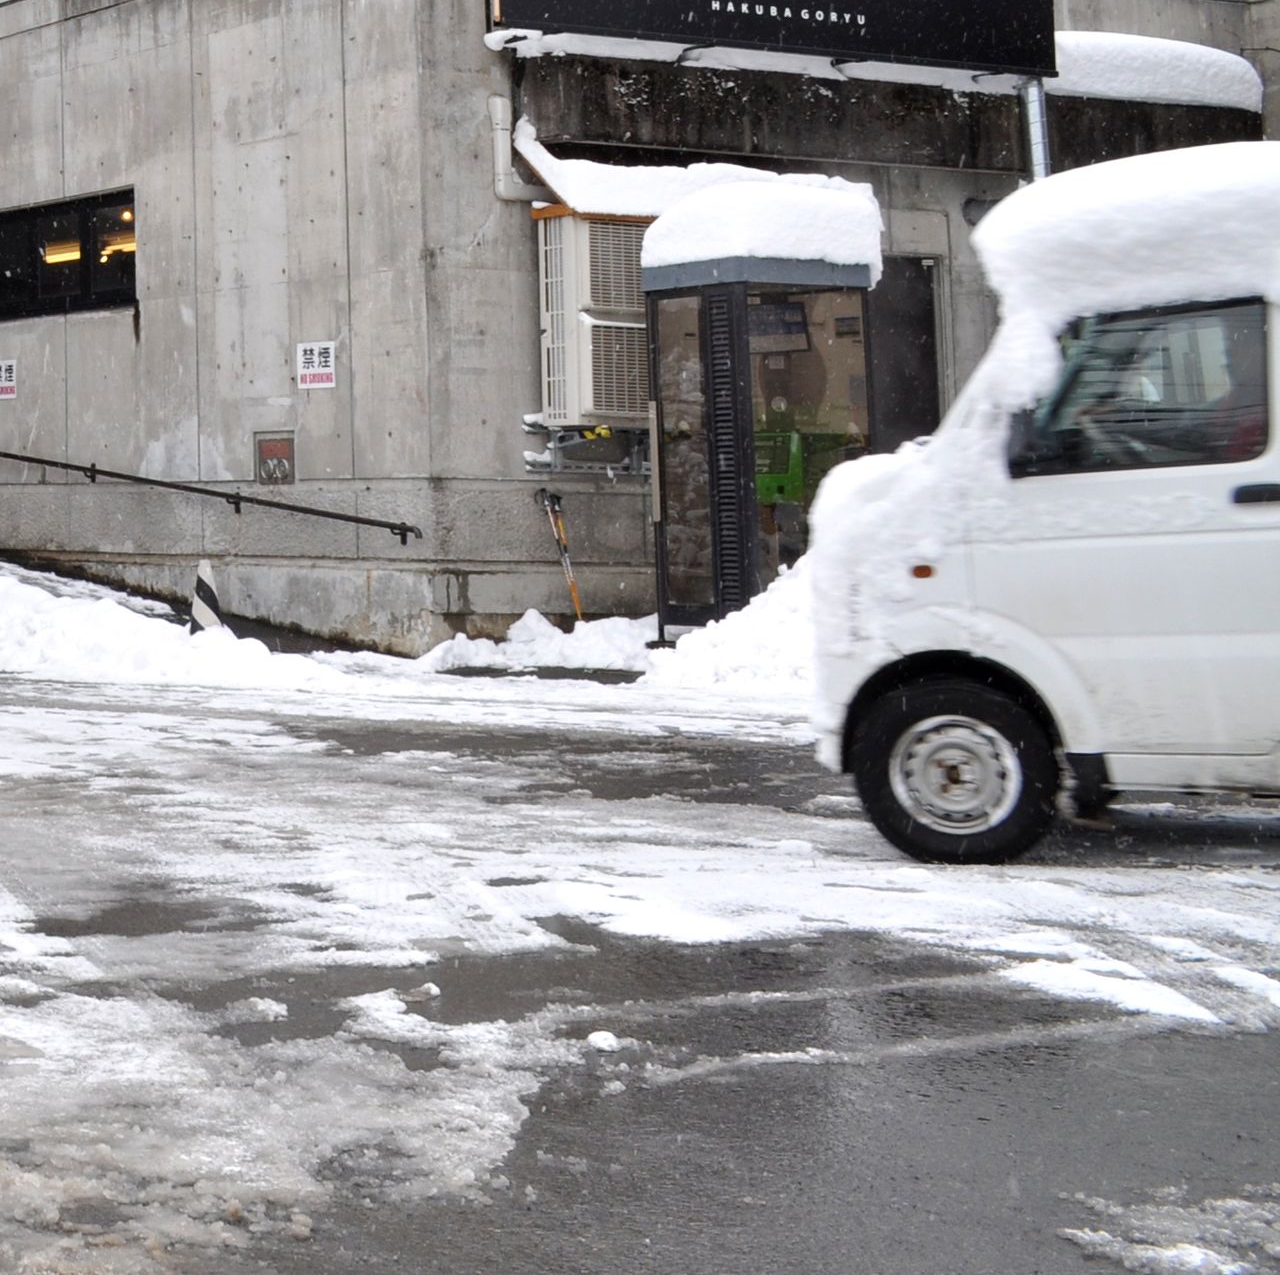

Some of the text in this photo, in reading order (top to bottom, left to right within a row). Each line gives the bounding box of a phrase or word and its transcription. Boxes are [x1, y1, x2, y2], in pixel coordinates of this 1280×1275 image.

[711, 0, 866, 25] HAKUBA GORYU
[301, 346, 332, 369] 禁煙
